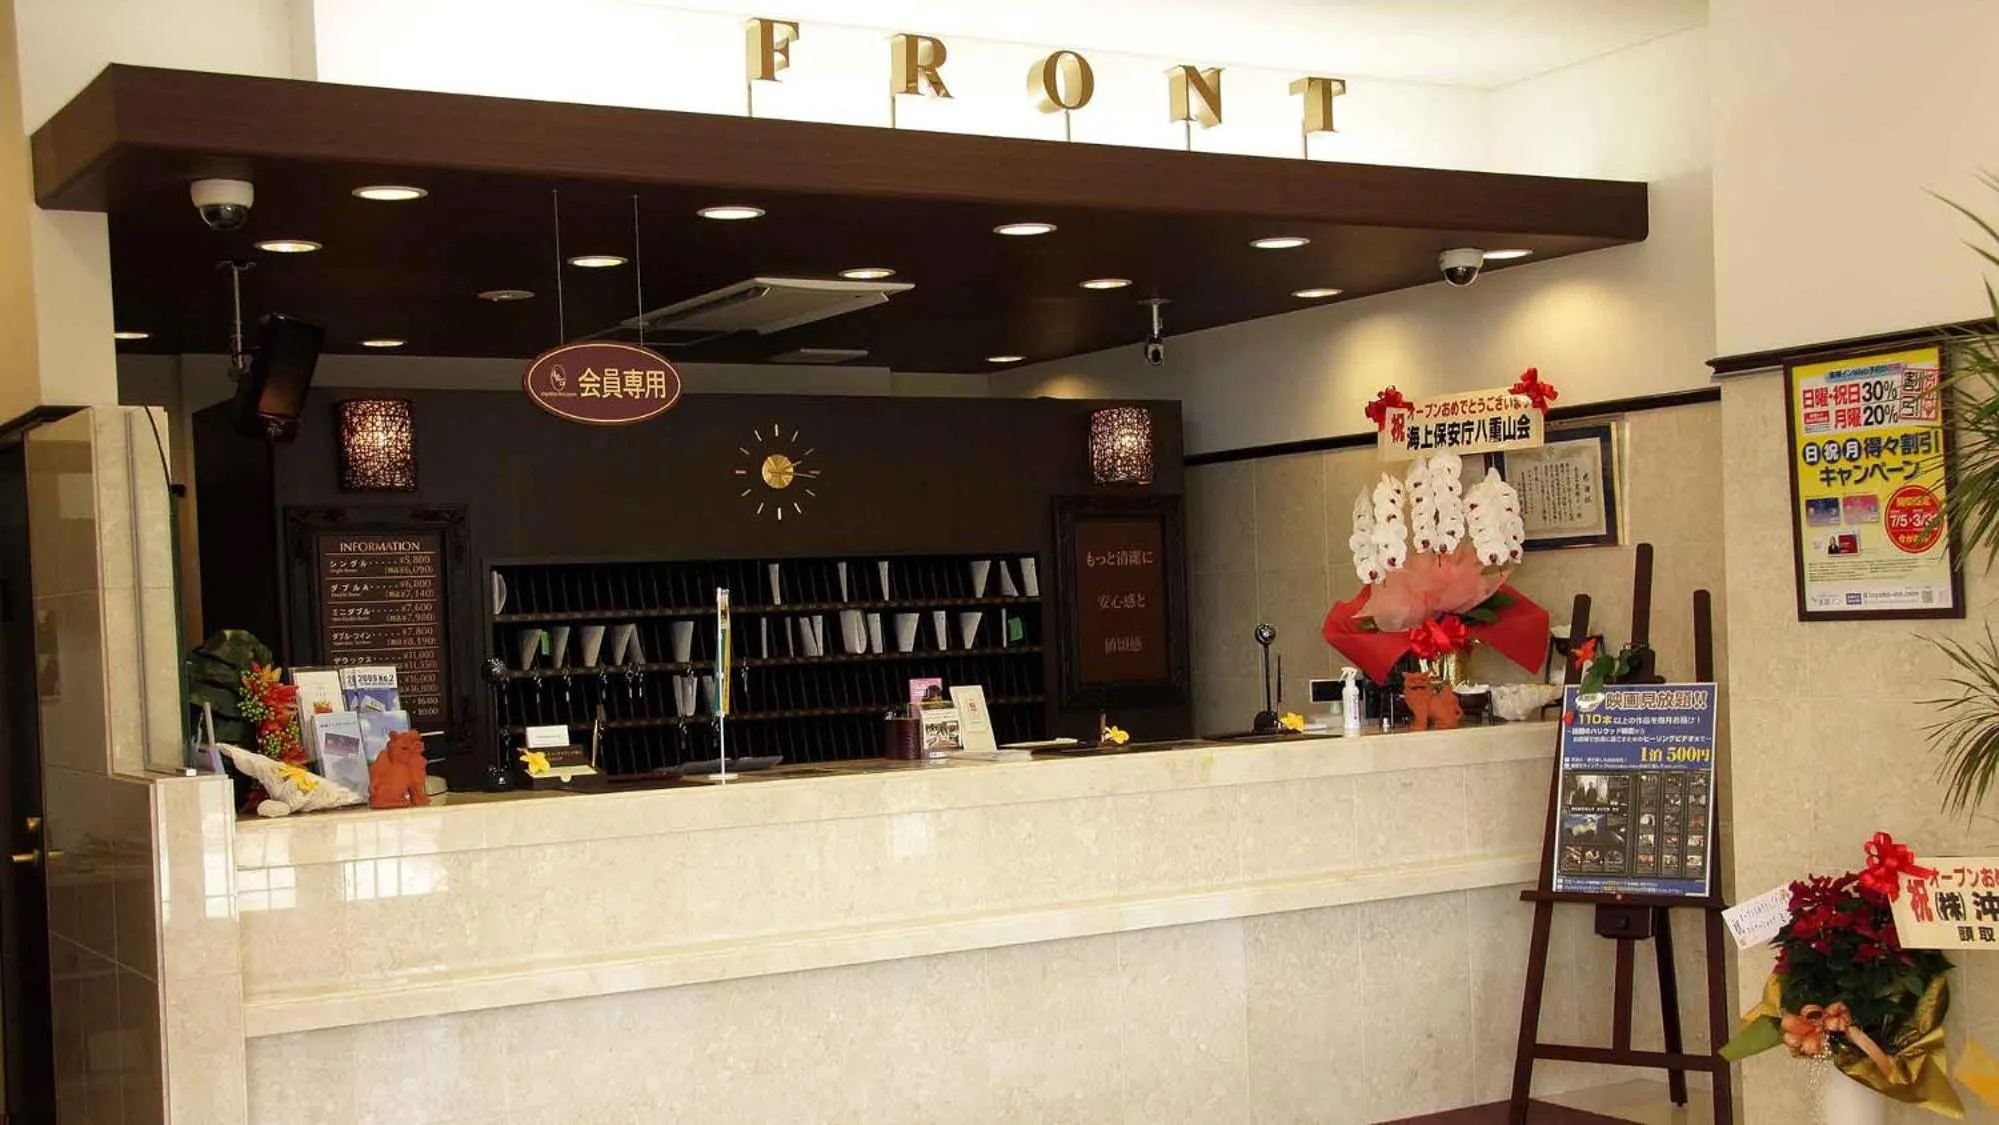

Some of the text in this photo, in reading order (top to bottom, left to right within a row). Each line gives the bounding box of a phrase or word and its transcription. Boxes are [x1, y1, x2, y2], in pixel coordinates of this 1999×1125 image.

[745, 17, 1347, 133] FRONT
[578, 367, 666, 399] 会員専用
[1391, 413, 1405, 442] 祝
[1834, 407, 1861, 430] 月曜
[1863, 404, 1899, 427] 20%
[1407, 414, 1531, 450] 海上保安庁八重山会
[1820, 461, 1919, 487] キャンペーン
[340, 541, 420, 553] INFORMATION
[1929, 867, 1999, 888] オープンお
[1907, 879, 1933, 922] 祝
